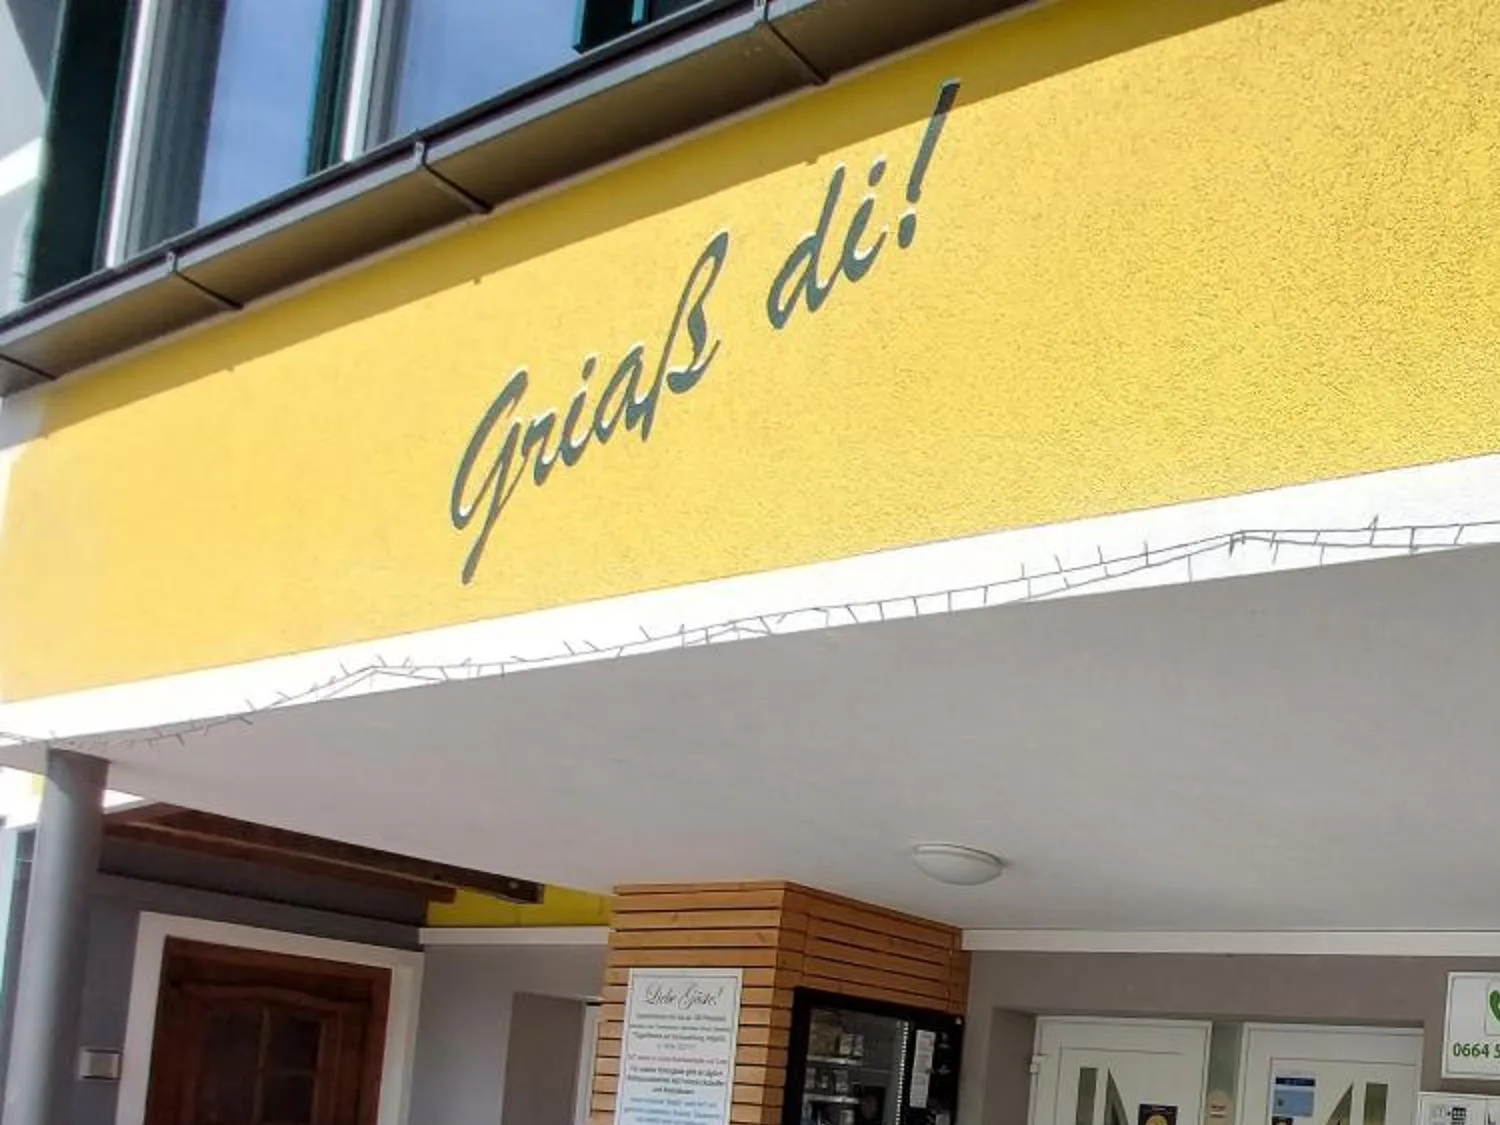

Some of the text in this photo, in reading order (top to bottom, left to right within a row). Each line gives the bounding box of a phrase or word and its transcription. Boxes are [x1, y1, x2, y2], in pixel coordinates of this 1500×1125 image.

[450, 79, 961, 586] Griaß di!
[1453, 1043, 1490, 1058] 0664
